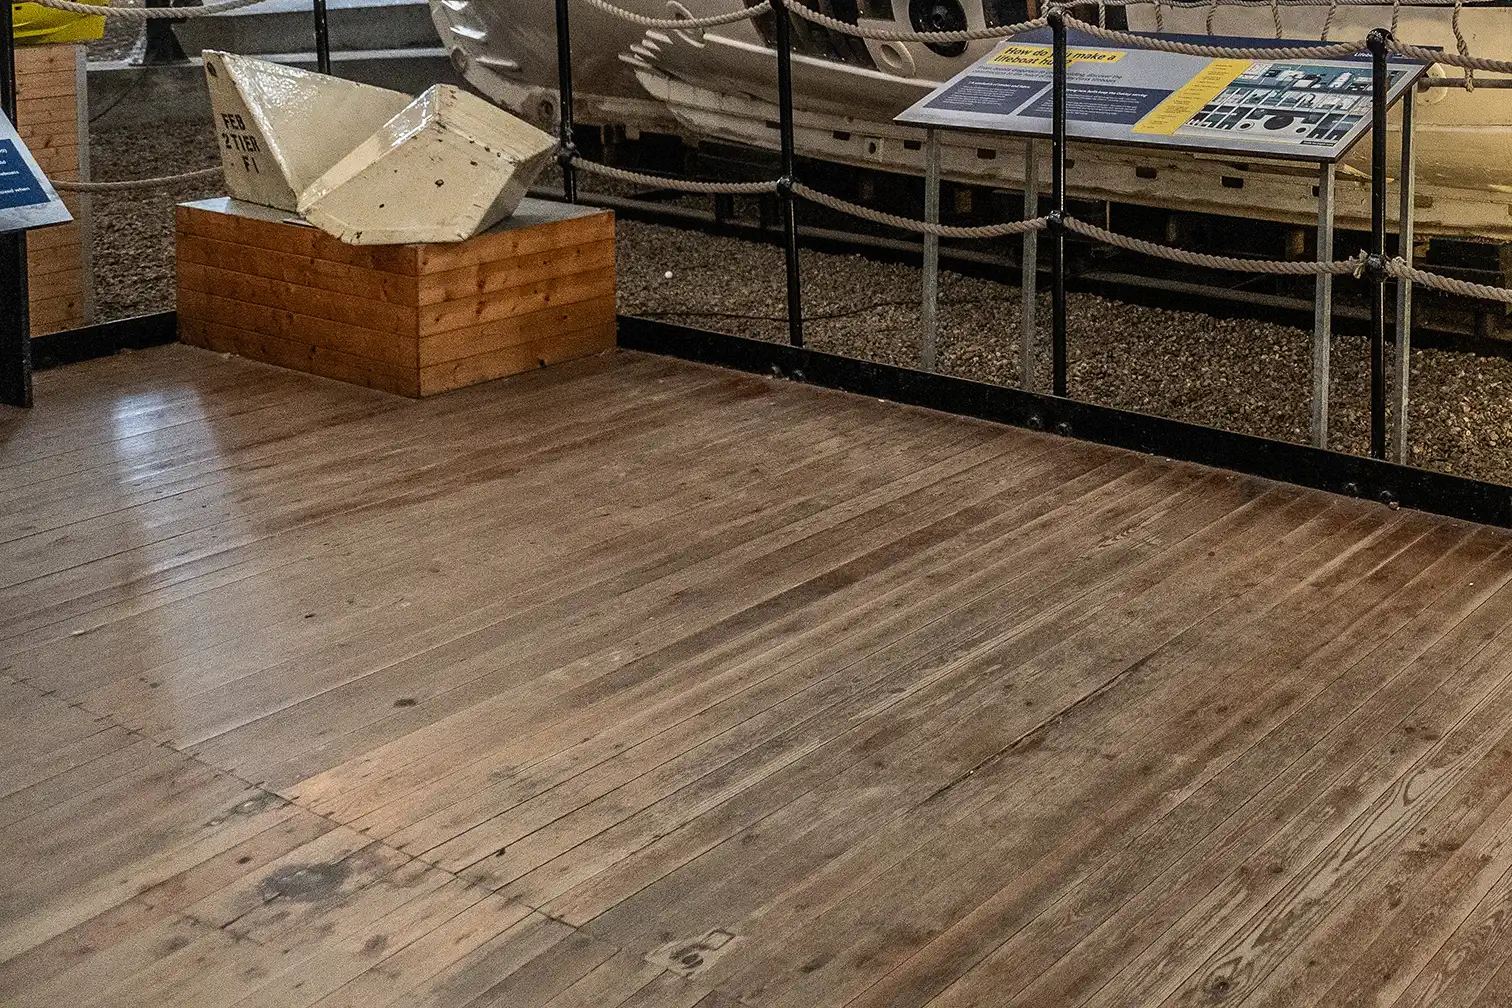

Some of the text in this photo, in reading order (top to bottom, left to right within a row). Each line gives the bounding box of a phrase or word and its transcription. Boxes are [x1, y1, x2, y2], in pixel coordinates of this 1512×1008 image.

[1004, 47, 1031, 55] How
[1032, 49, 1049, 57] do
[993, 55, 1036, 64] lifeboat
[220, 113, 245, 130] FEB
